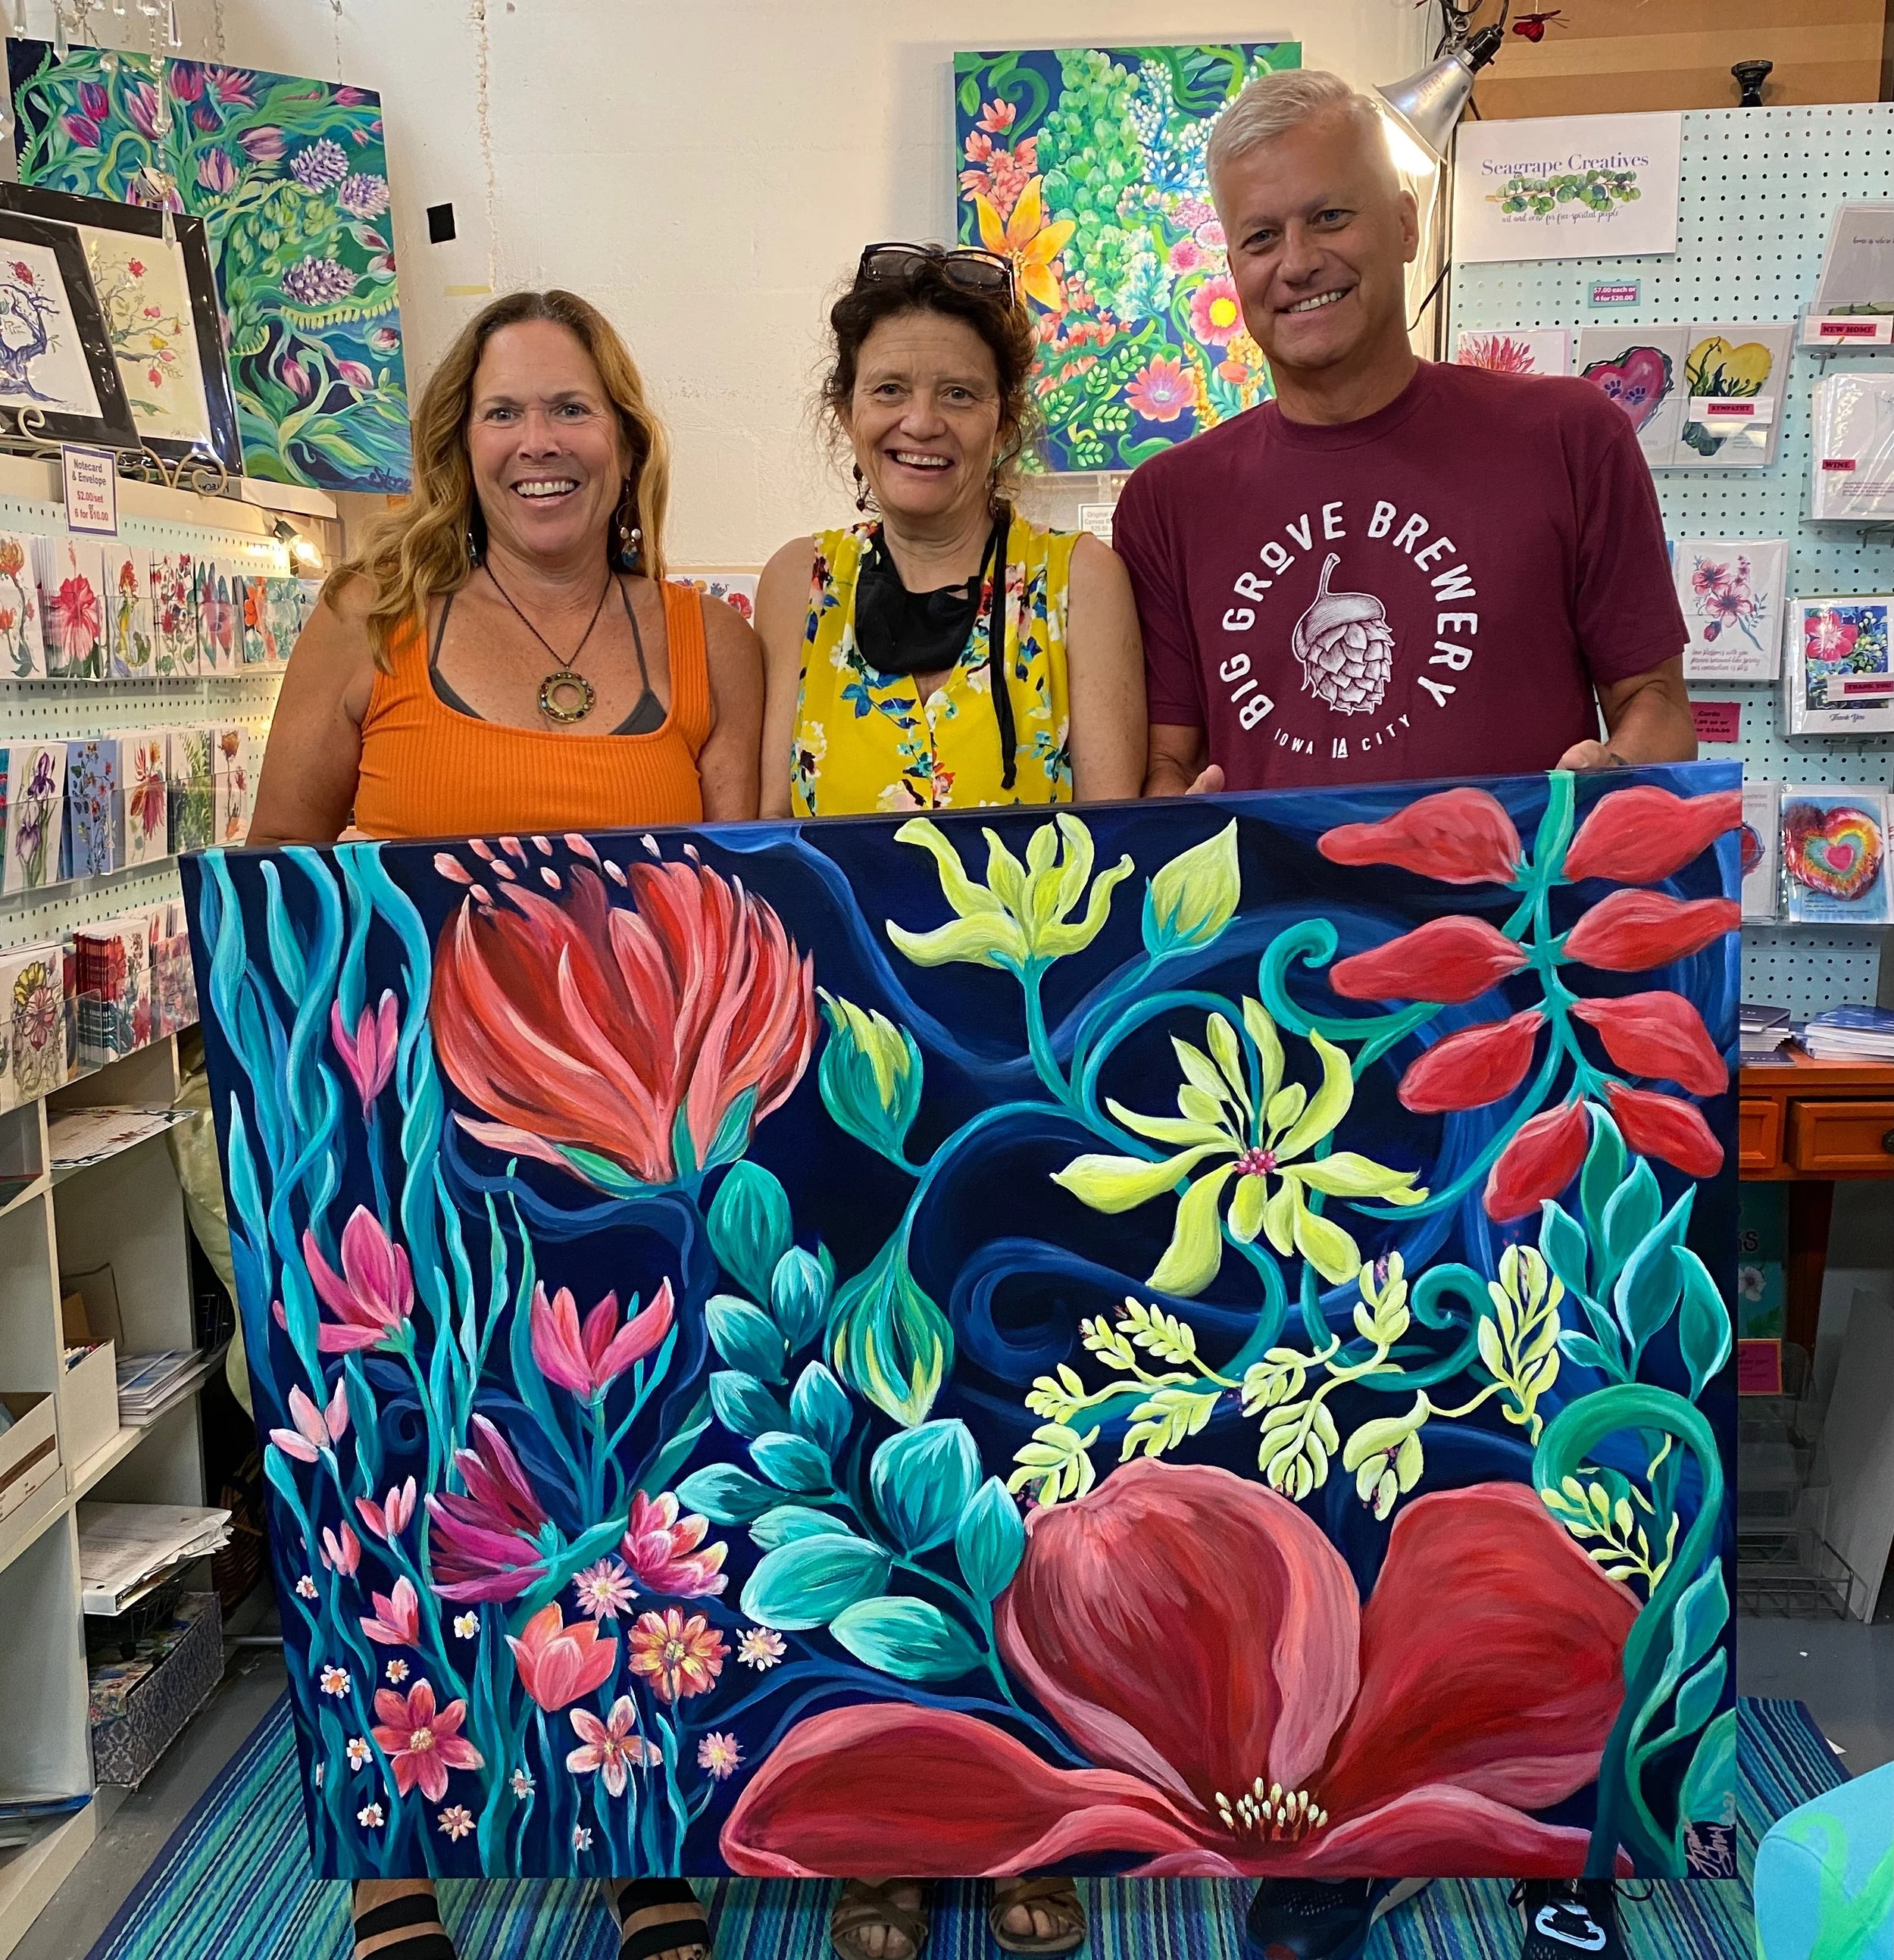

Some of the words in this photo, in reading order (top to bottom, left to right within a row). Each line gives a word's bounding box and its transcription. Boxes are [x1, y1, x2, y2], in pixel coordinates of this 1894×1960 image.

[1482, 159, 1562, 178] Seagrape
[1568, 152, 1649, 171] Creatives
[72, 470, 77, 480] &
[78, 472, 106, 487] Envelope
[73, 459, 102, 473] Notecard
[74, 508, 79, 517] 6
[80, 509, 88, 518] for
[89, 511, 108, 521] $10.00
[1222, 501, 1346, 631] GROVE
[1367, 500, 1477, 708] BREWERY
[1220, 653, 1275, 730] BIG
[1829, 713, 1849, 721] Thank
[1851, 714, 1865, 723] You
[1274, 727, 1314, 755] IOWA
[1361, 714, 1411, 752] CITY
